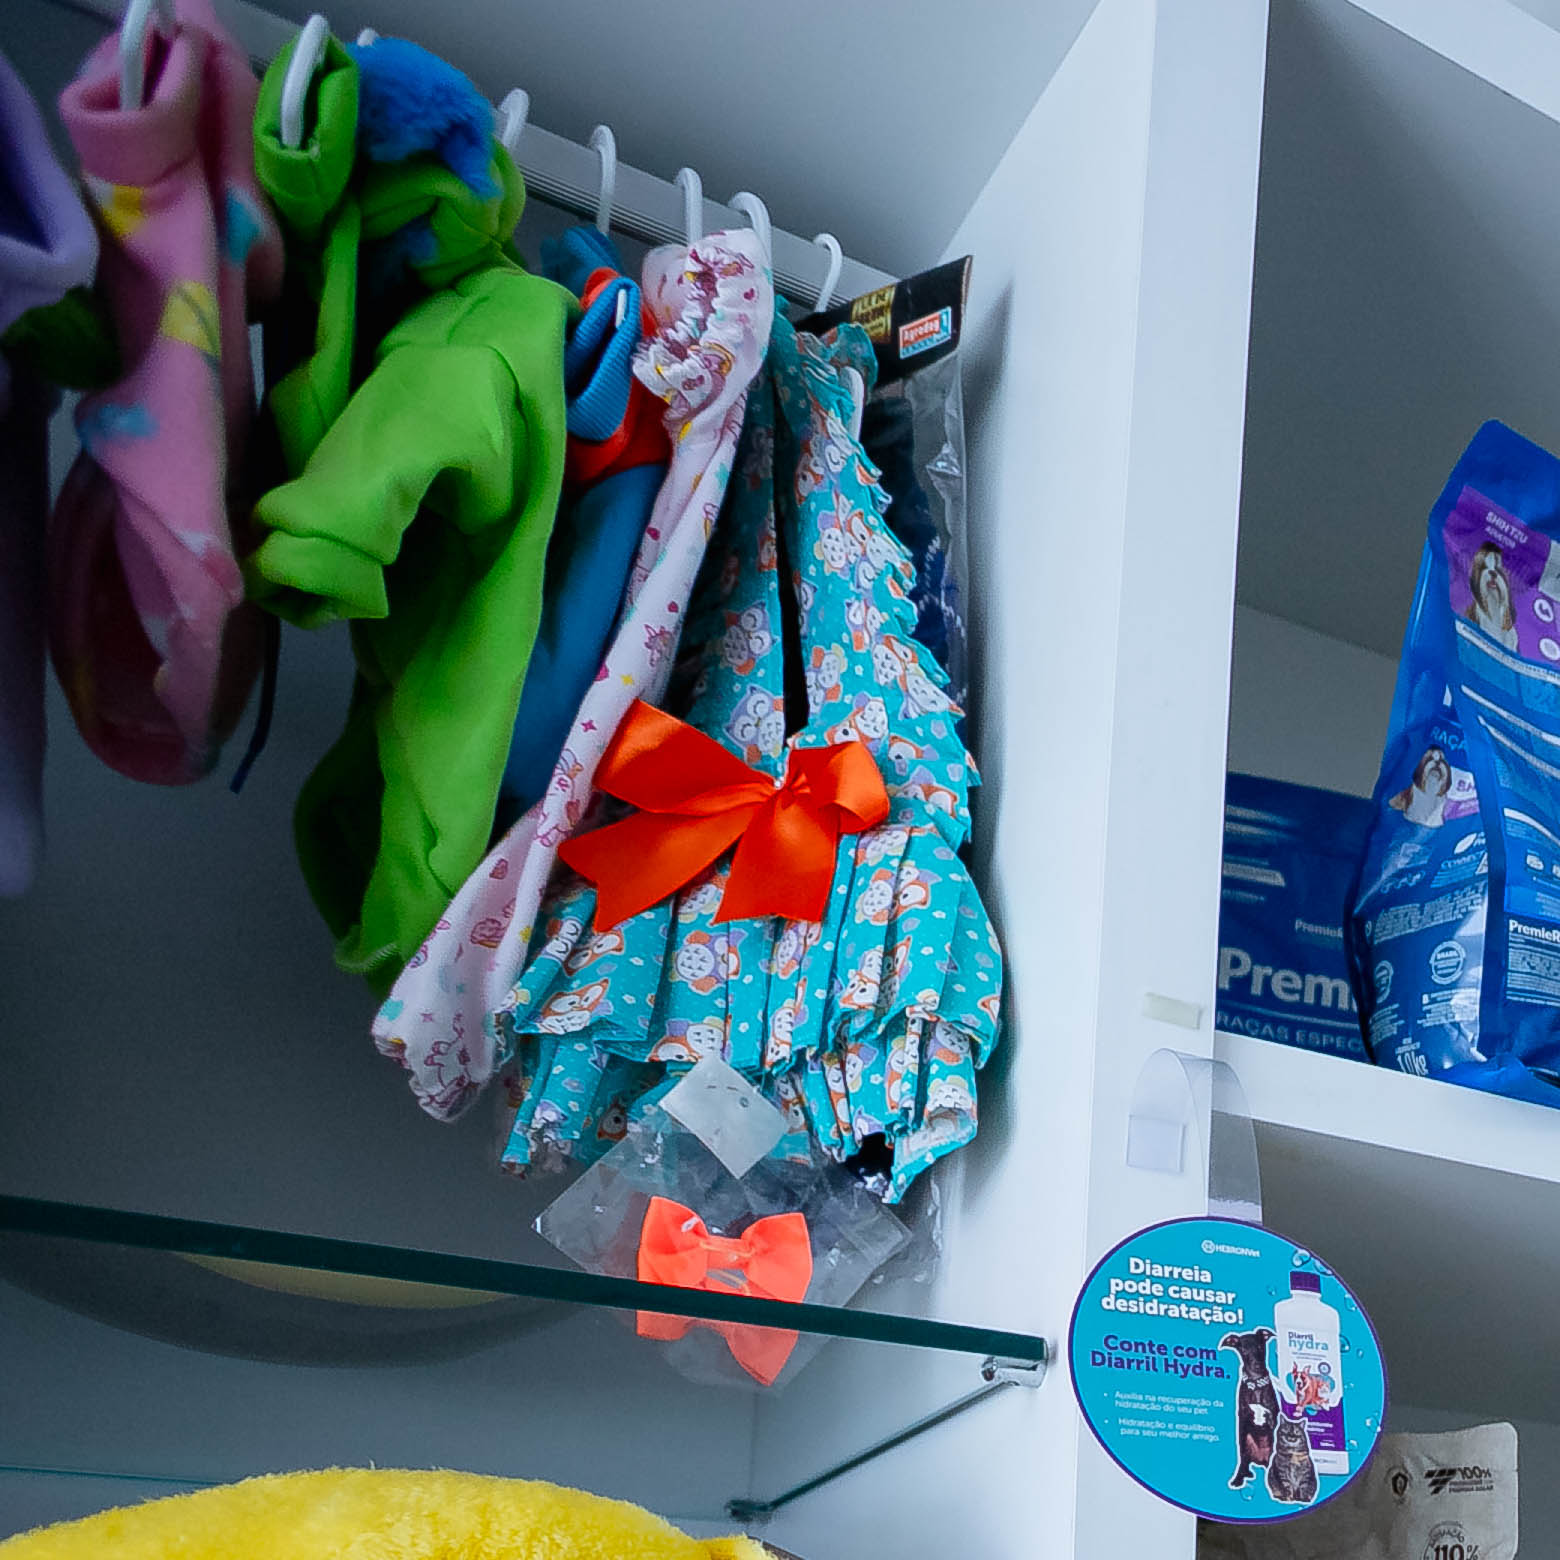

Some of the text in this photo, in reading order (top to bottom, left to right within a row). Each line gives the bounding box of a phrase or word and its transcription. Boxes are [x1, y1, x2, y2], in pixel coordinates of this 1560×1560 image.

[1218, 947, 1359, 1013] Prem
[1129, 1257, 1212, 1283] Diarreia
[1110, 1276, 1236, 1305] pode causar
[1101, 1294, 1244, 1325] desidratação!
[1103, 1334, 1217, 1360] Conte com
[1091, 1351, 1231, 1381] Diarril Hydra.
